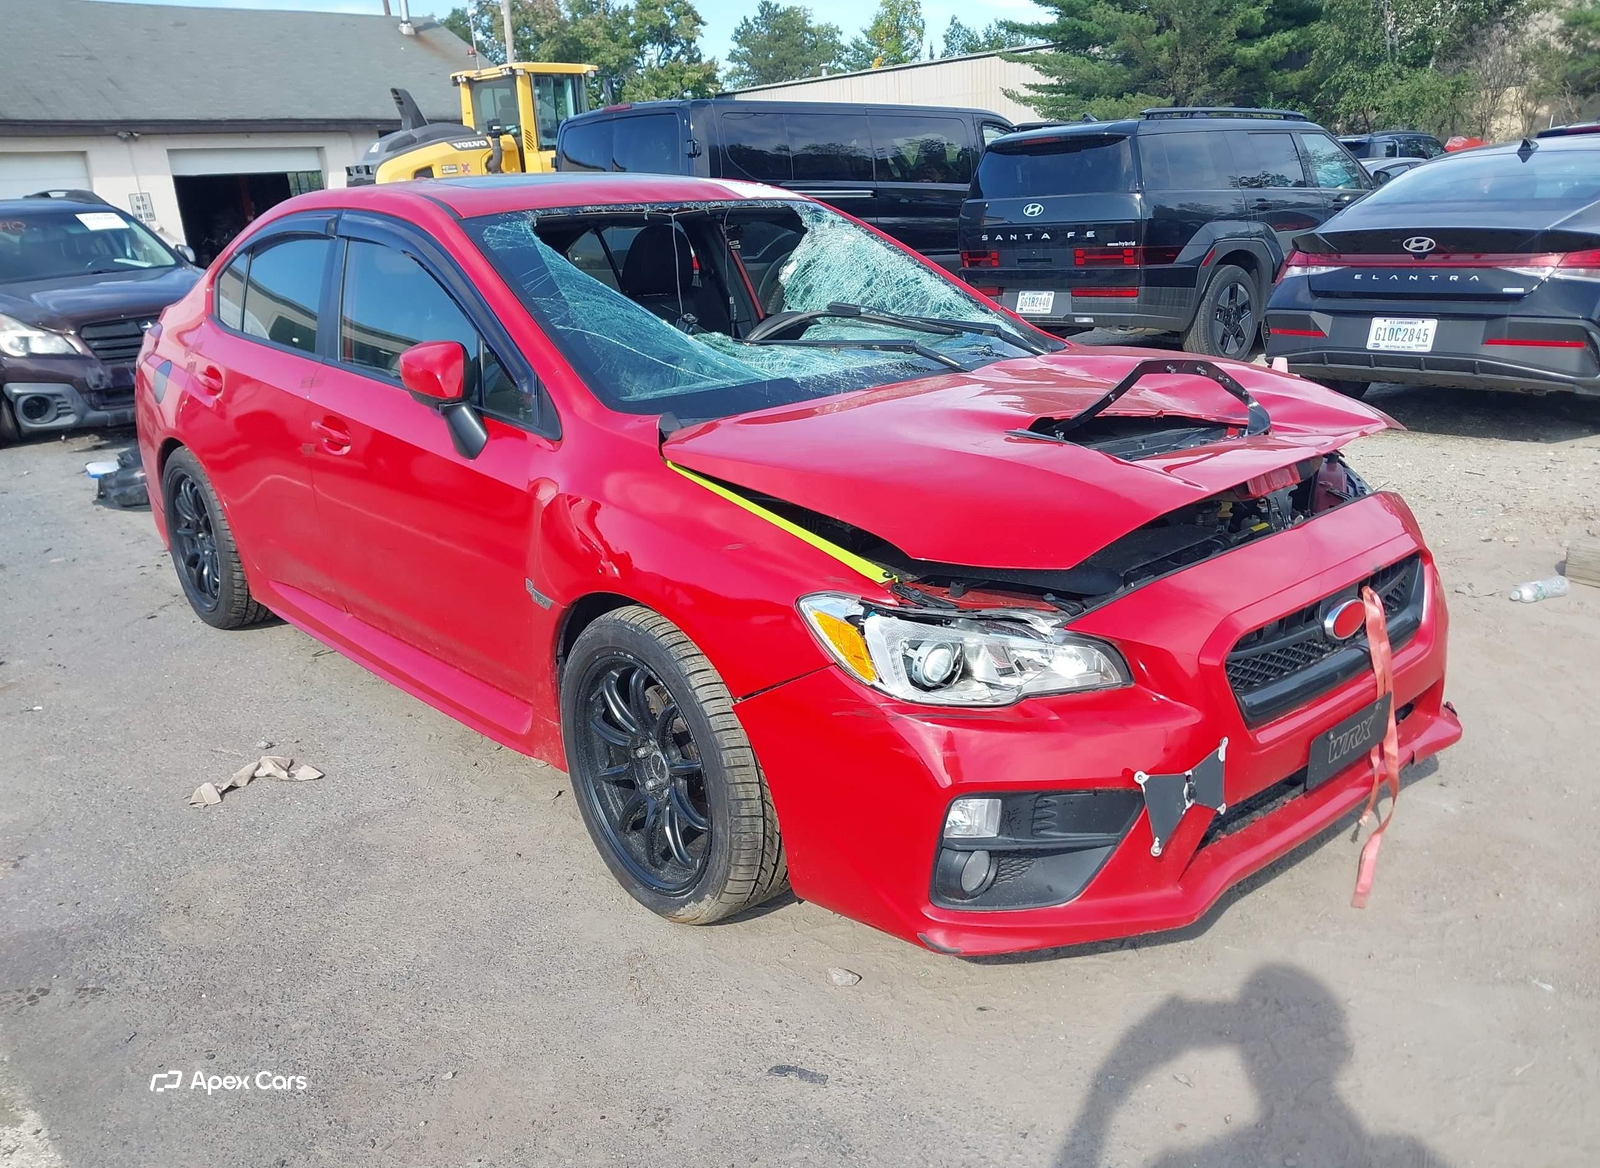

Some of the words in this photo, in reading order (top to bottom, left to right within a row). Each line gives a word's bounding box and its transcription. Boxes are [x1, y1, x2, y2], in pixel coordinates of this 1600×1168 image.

[453, 140, 488, 149] VOLVO
[135, 203, 148, 211] NT
[981, 232, 1051, 241] SANTA
[1067, 230, 1096, 239] FE
[1118, 240, 1136, 248] hybrid
[1374, 326, 1430, 343] G10C2845
[1328, 714, 1375, 764] WRX
